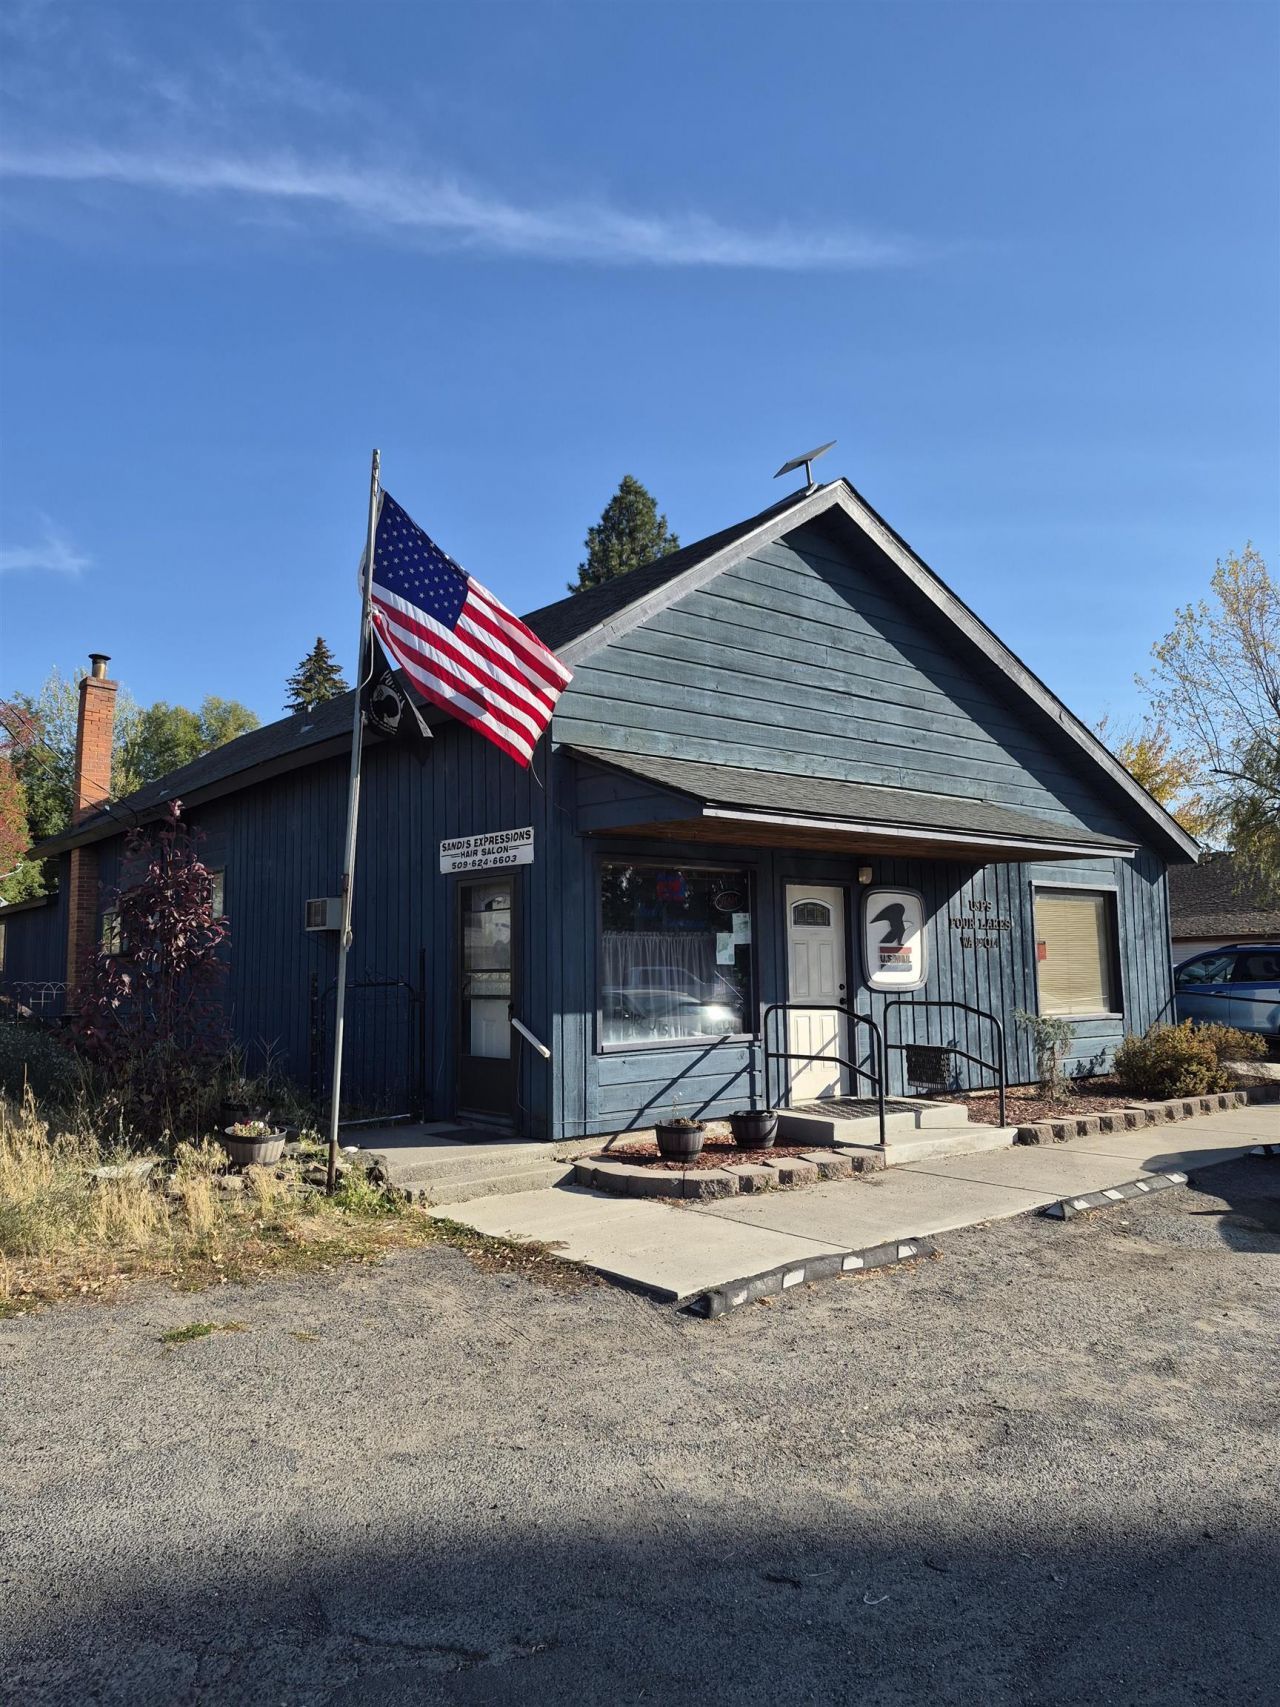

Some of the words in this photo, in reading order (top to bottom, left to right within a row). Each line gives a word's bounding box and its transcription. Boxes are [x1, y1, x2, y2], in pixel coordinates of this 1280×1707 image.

[474, 830, 531, 847] EXPRESSIONS
[461, 849, 478, 859] HAIR
[481, 845, 509, 856] SALON
[968, 900, 992, 912] USPS
[978, 919, 1011, 931] LAKES
